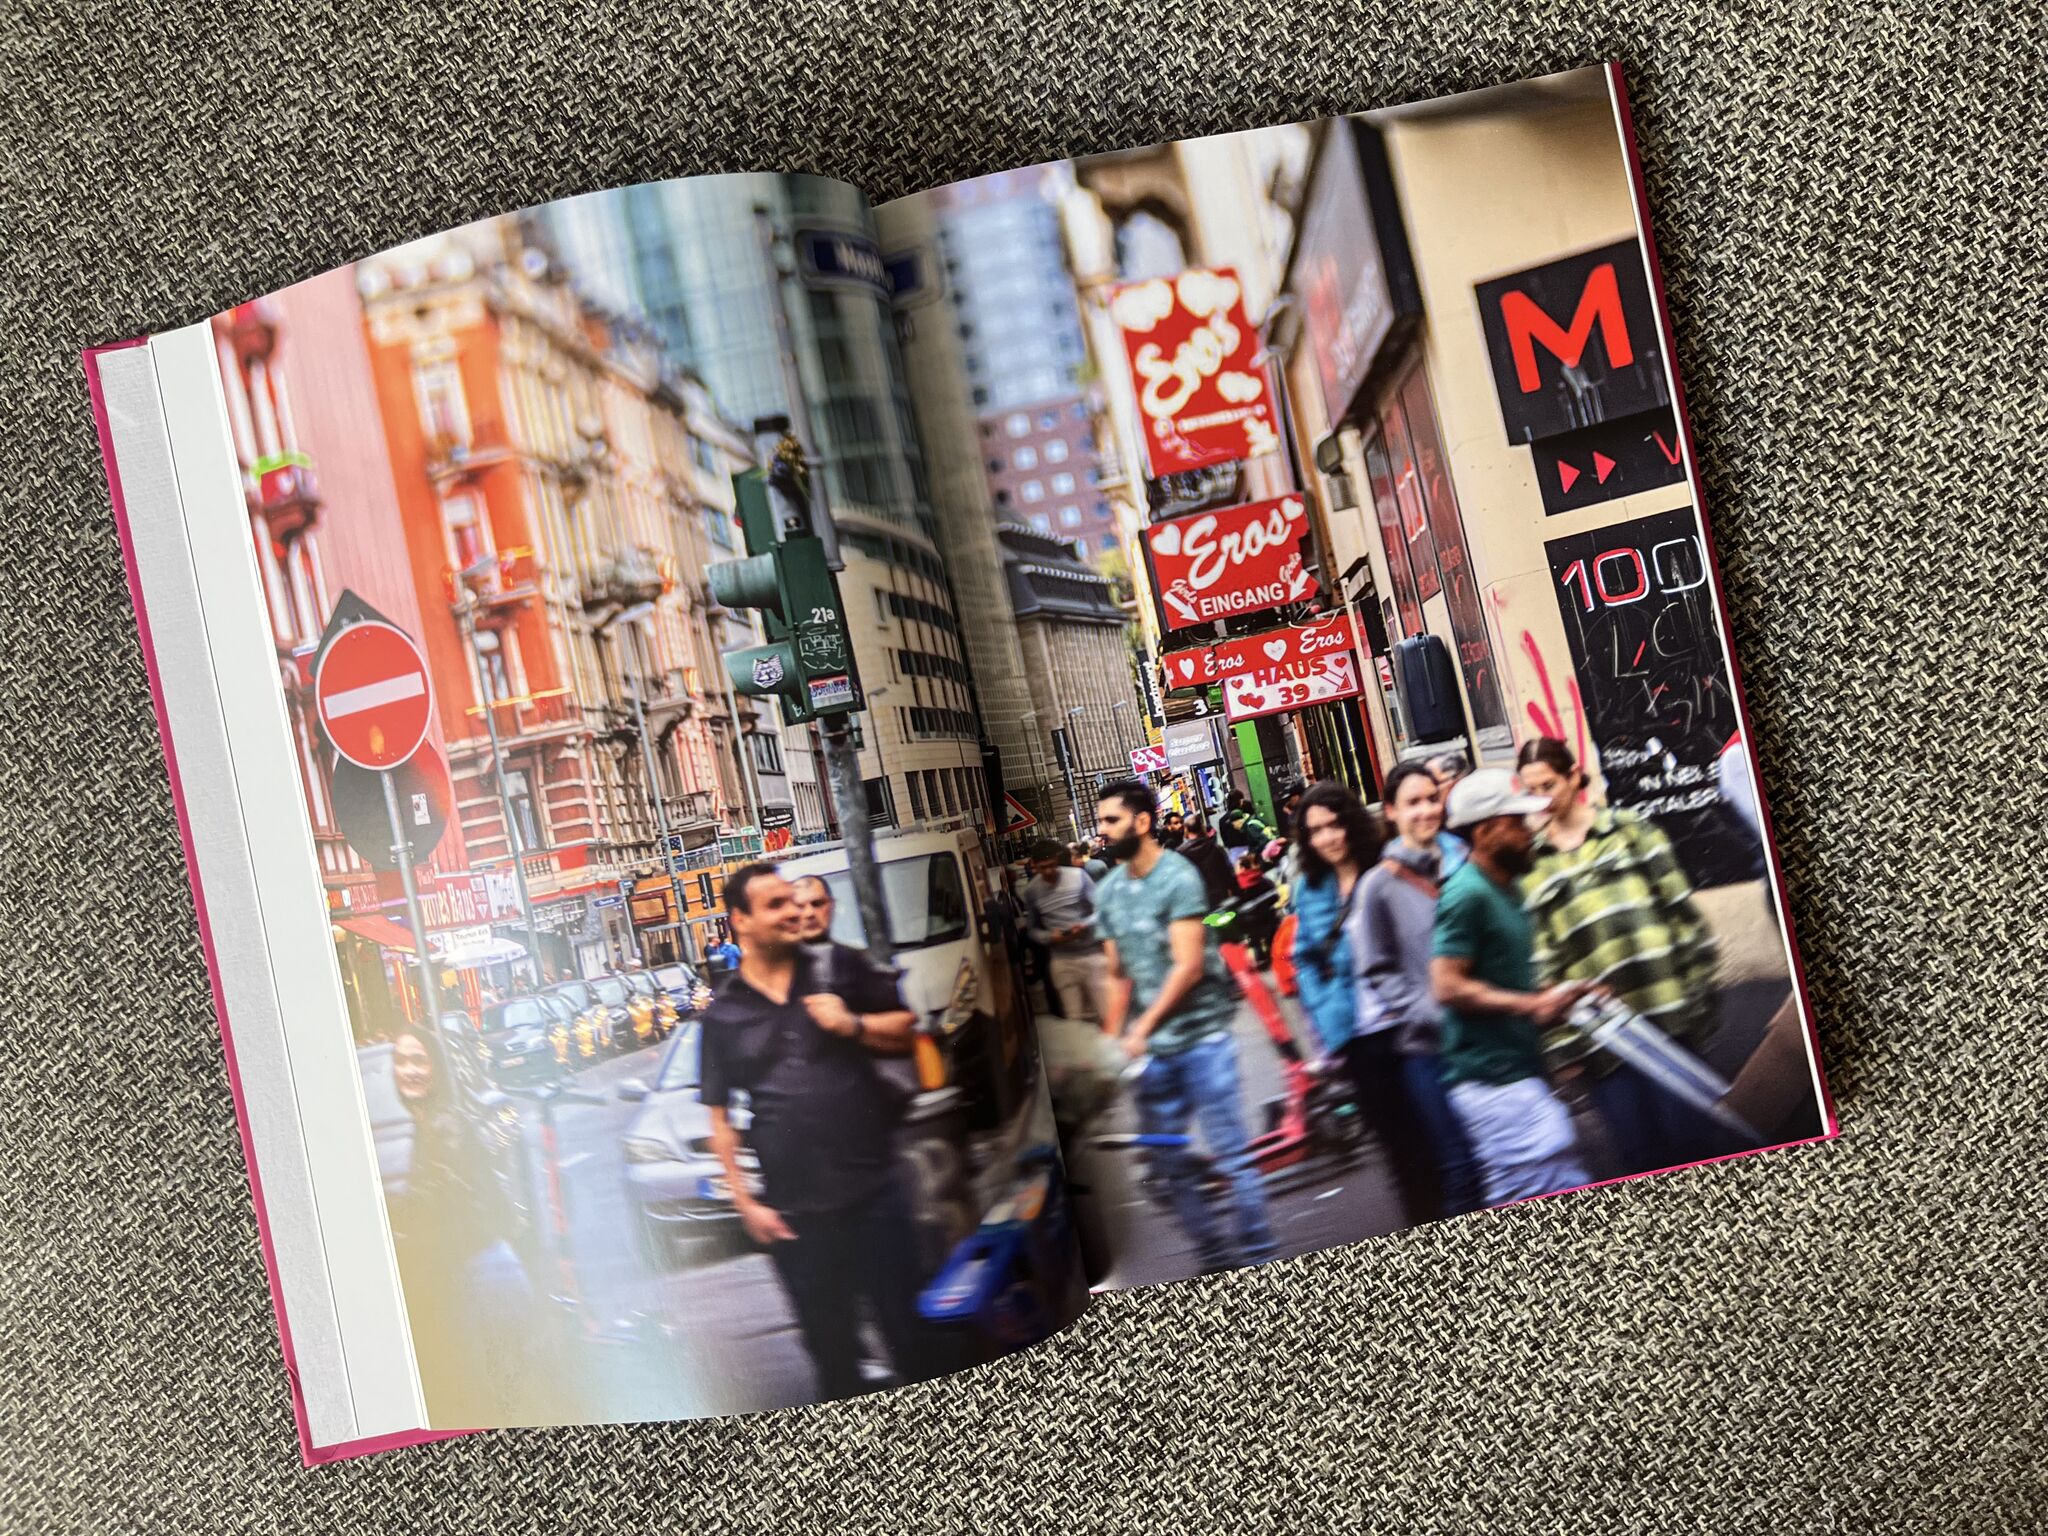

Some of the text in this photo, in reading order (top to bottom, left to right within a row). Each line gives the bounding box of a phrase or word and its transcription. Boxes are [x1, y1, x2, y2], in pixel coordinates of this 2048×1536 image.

[1499, 262, 1634, 393] M
[1136, 312, 1241, 419] Eros
[1182, 508, 1293, 590] Eros
[1170, 578, 1199, 605] Girls
[1560, 534, 1708, 613] 100
[811, 606, 836, 624] 21a
[1199, 582, 1285, 617] EINGANG
[1203, 626, 1346, 677] Eros Eros
[1252, 656, 1329, 688] HAUS
[1278, 683, 1311, 705] 39
